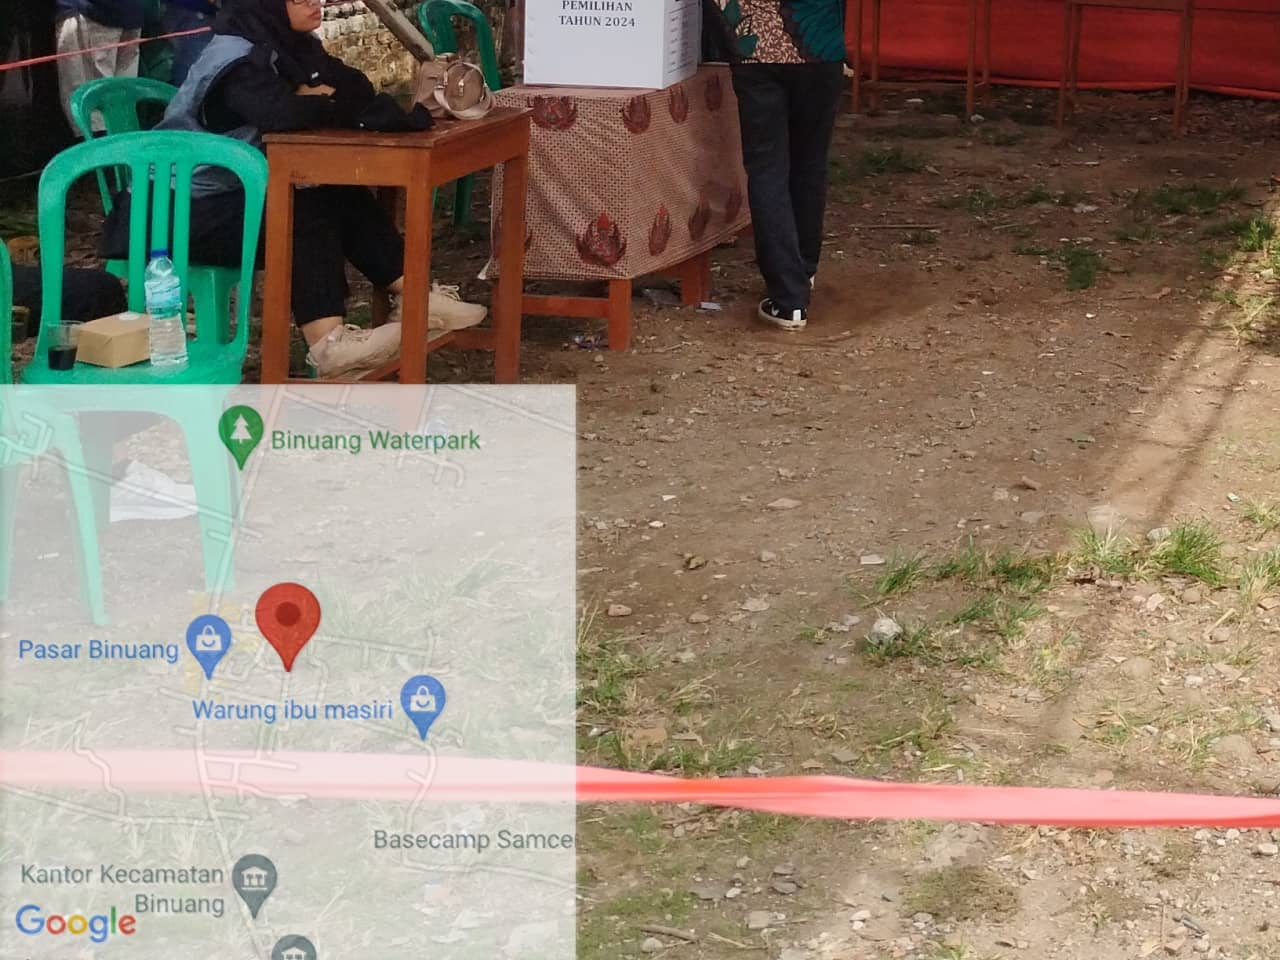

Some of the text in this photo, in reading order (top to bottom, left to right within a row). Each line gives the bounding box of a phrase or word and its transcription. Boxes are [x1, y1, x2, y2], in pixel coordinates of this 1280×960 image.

[562, 0, 634, 12] PEMILIHAN
[558, 15, 636, 28] TAHUN 2024
